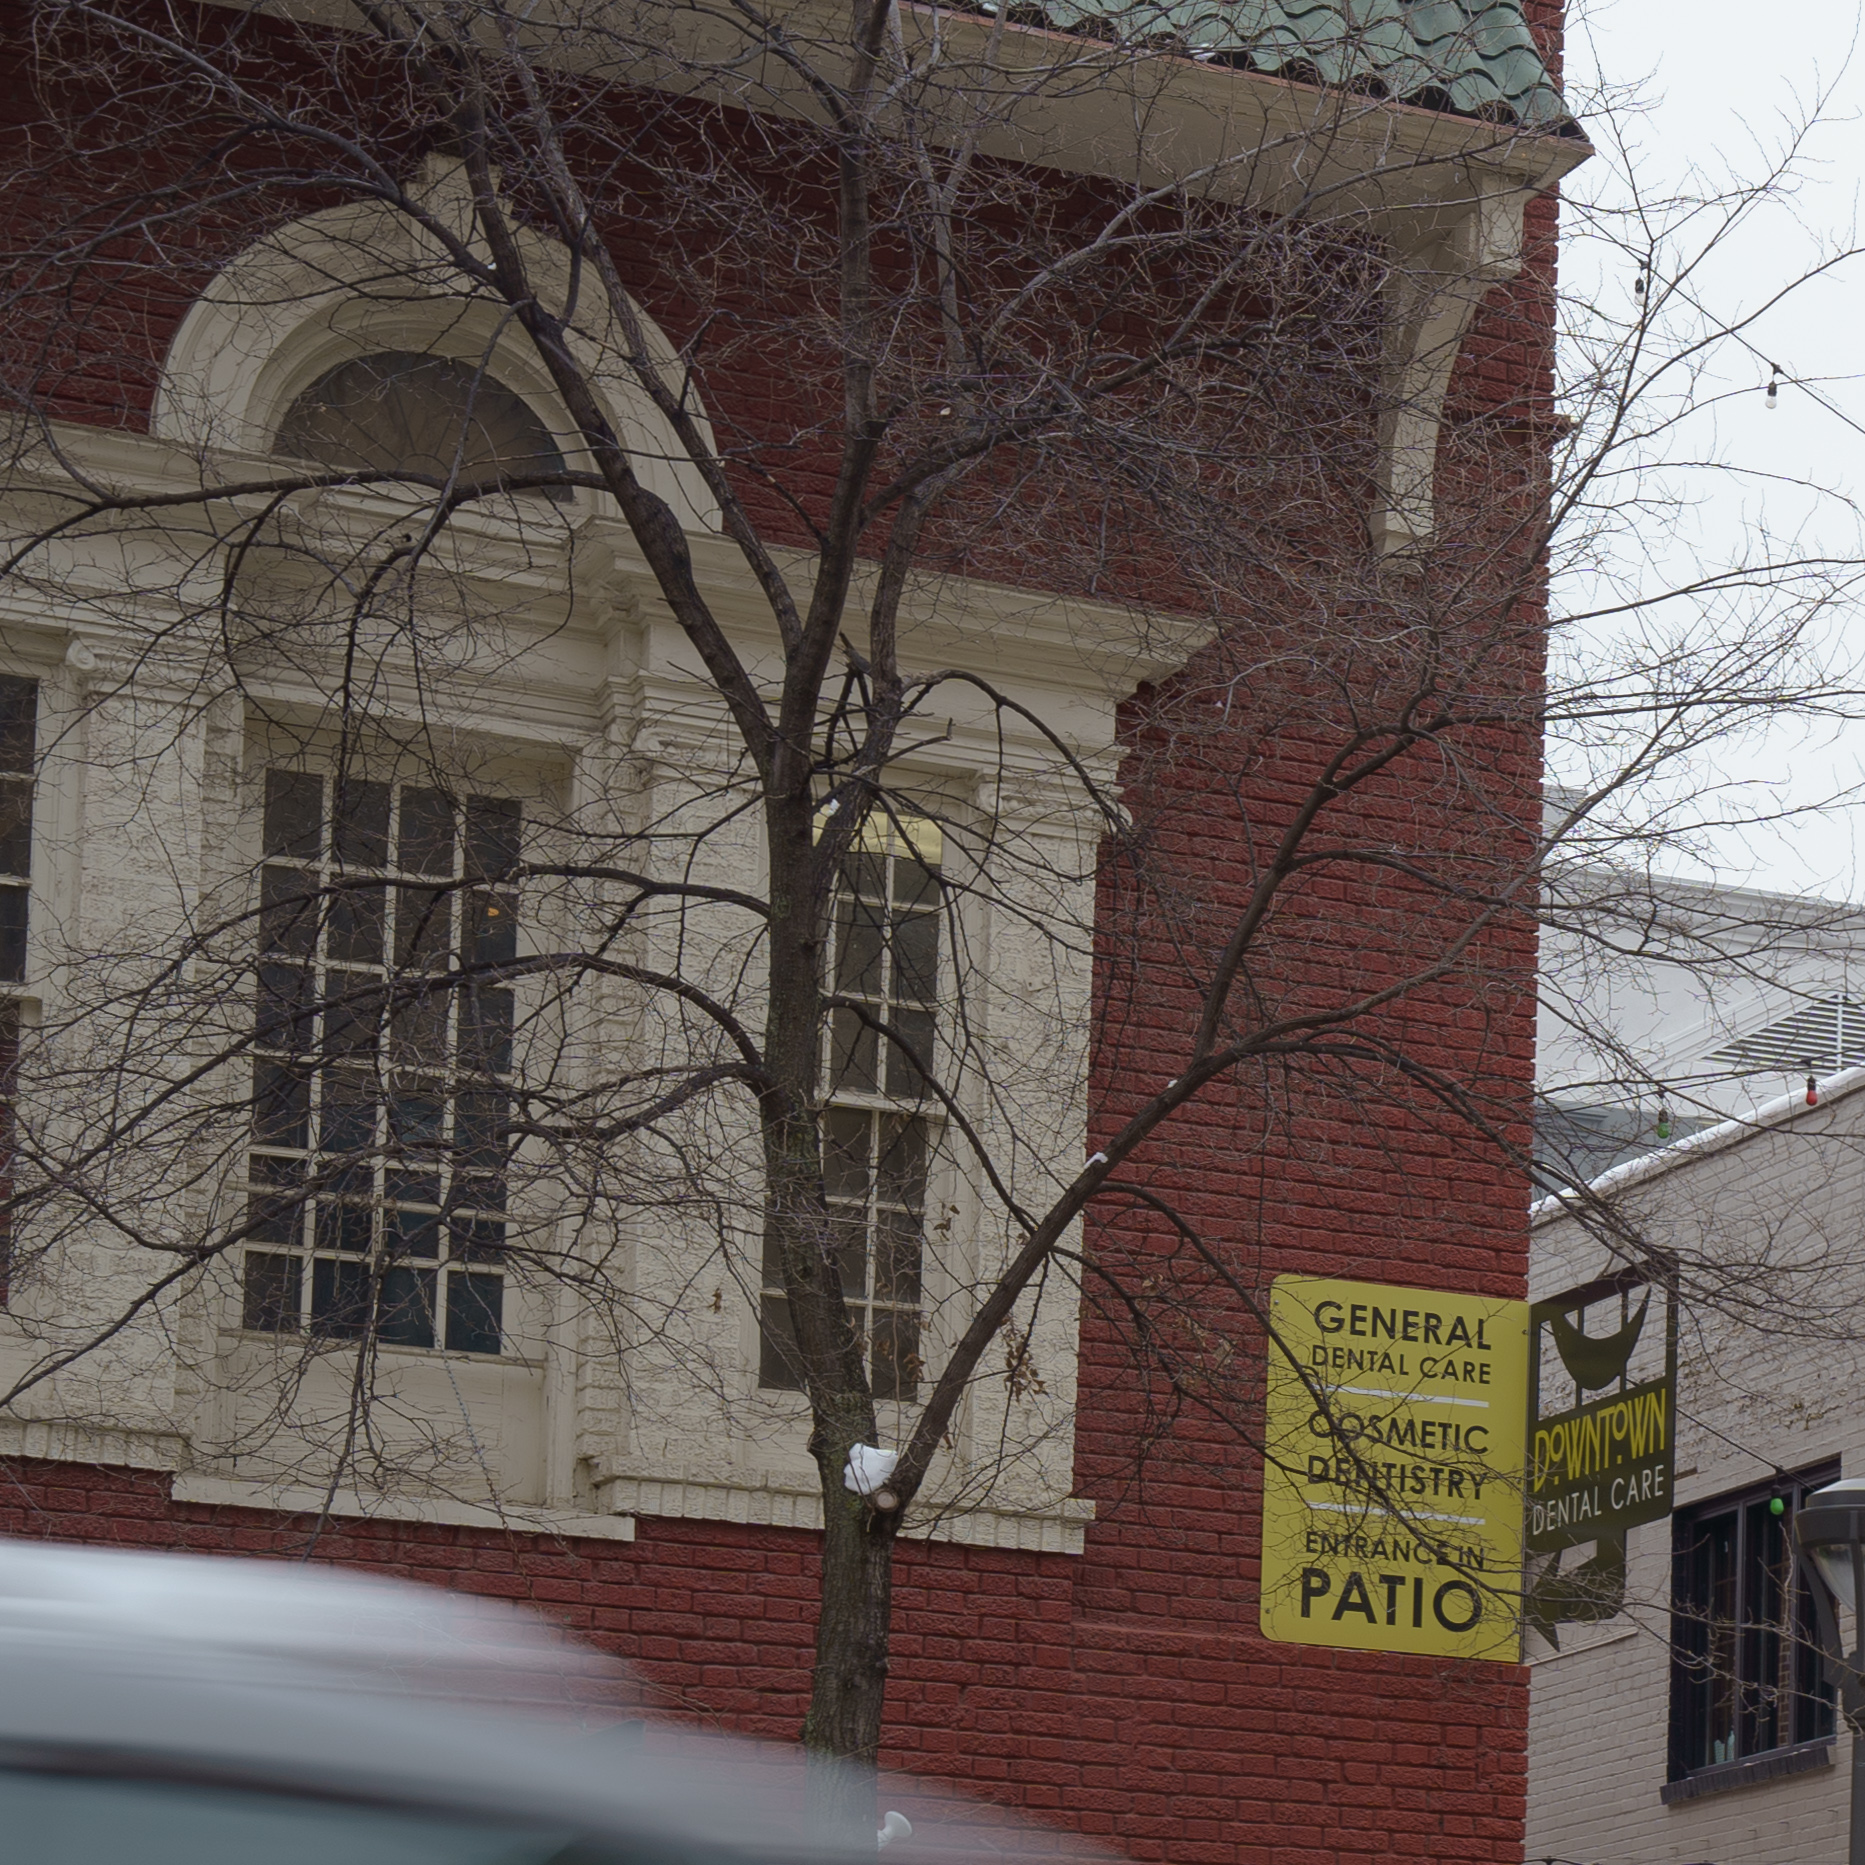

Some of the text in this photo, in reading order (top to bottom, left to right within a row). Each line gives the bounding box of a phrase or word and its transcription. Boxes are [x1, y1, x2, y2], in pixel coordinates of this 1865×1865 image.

[1313, 1300, 1492, 1351] GENERAL
[1311, 1344, 1491, 1385] DENTAL CARE
[1308, 1411, 1489, 1456] COSMETIC
[1534, 1388, 1667, 1493] DOWNTOWN
[1307, 1455, 1488, 1500] DENTISTRY
[1532, 1464, 1664, 1537] DENTAL CARE
[1305, 1531, 1485, 1569] ENTRANCE IN
[1300, 1566, 1482, 1633] PATIO
